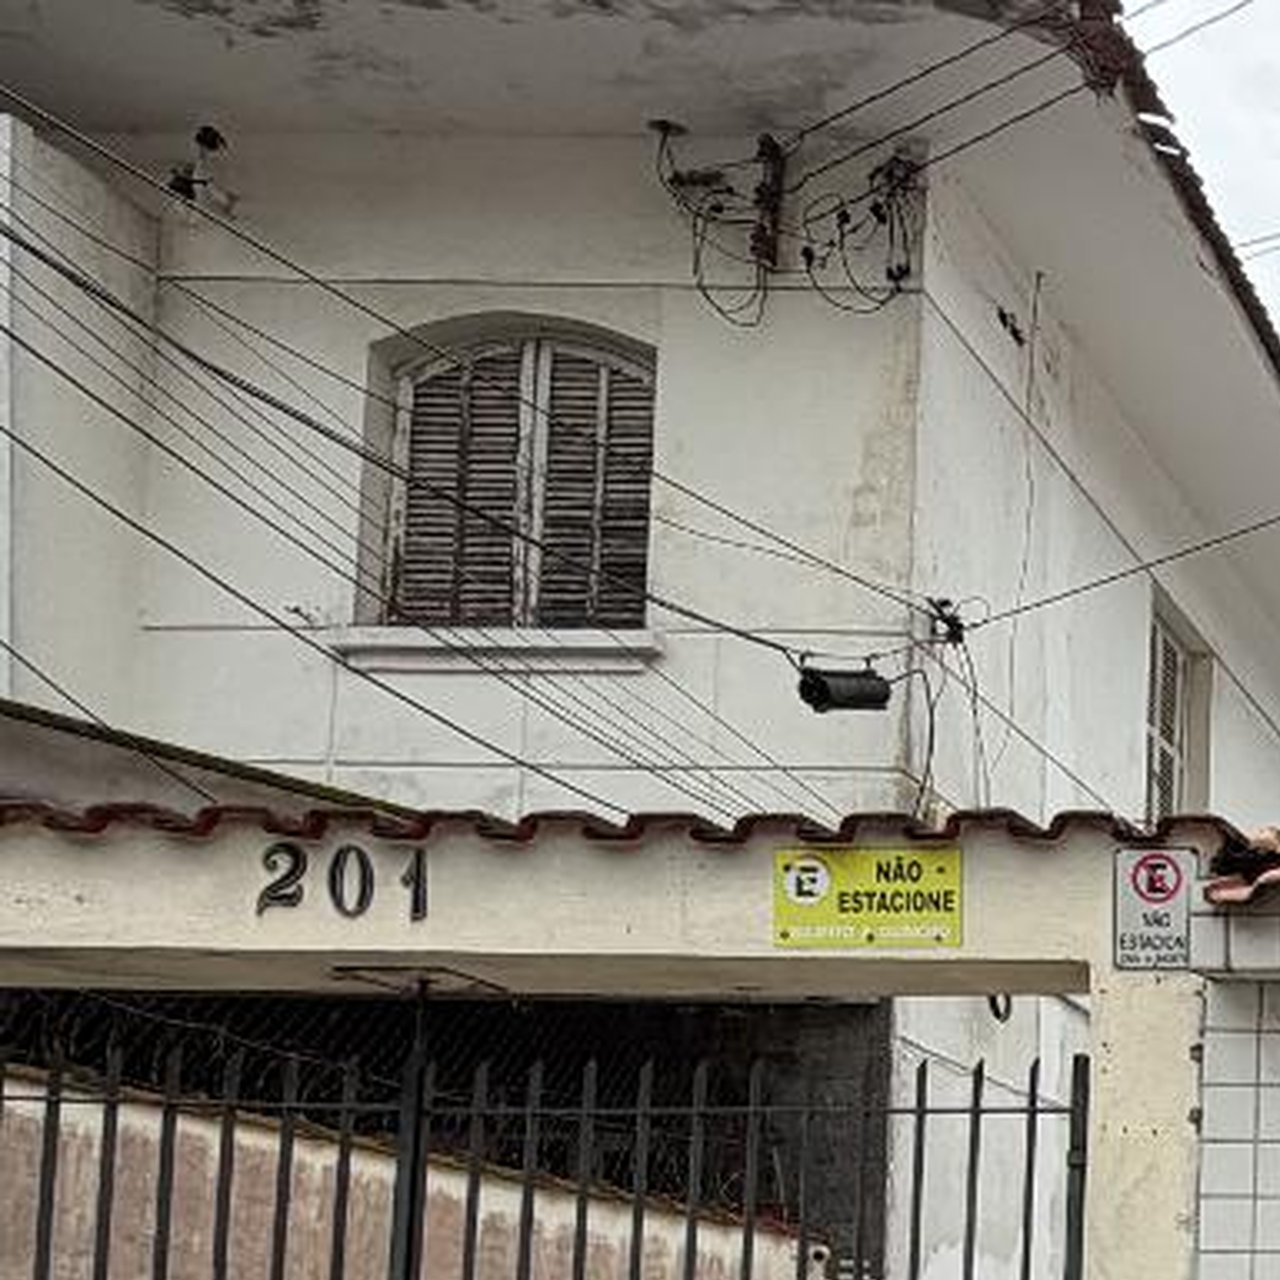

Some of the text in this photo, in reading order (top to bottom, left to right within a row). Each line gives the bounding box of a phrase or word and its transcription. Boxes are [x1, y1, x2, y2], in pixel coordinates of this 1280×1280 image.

[256, 842, 428, 922] 201
[876, 855, 923, 883] NÃO
[838, 890, 957, 913] ESTACIONE
